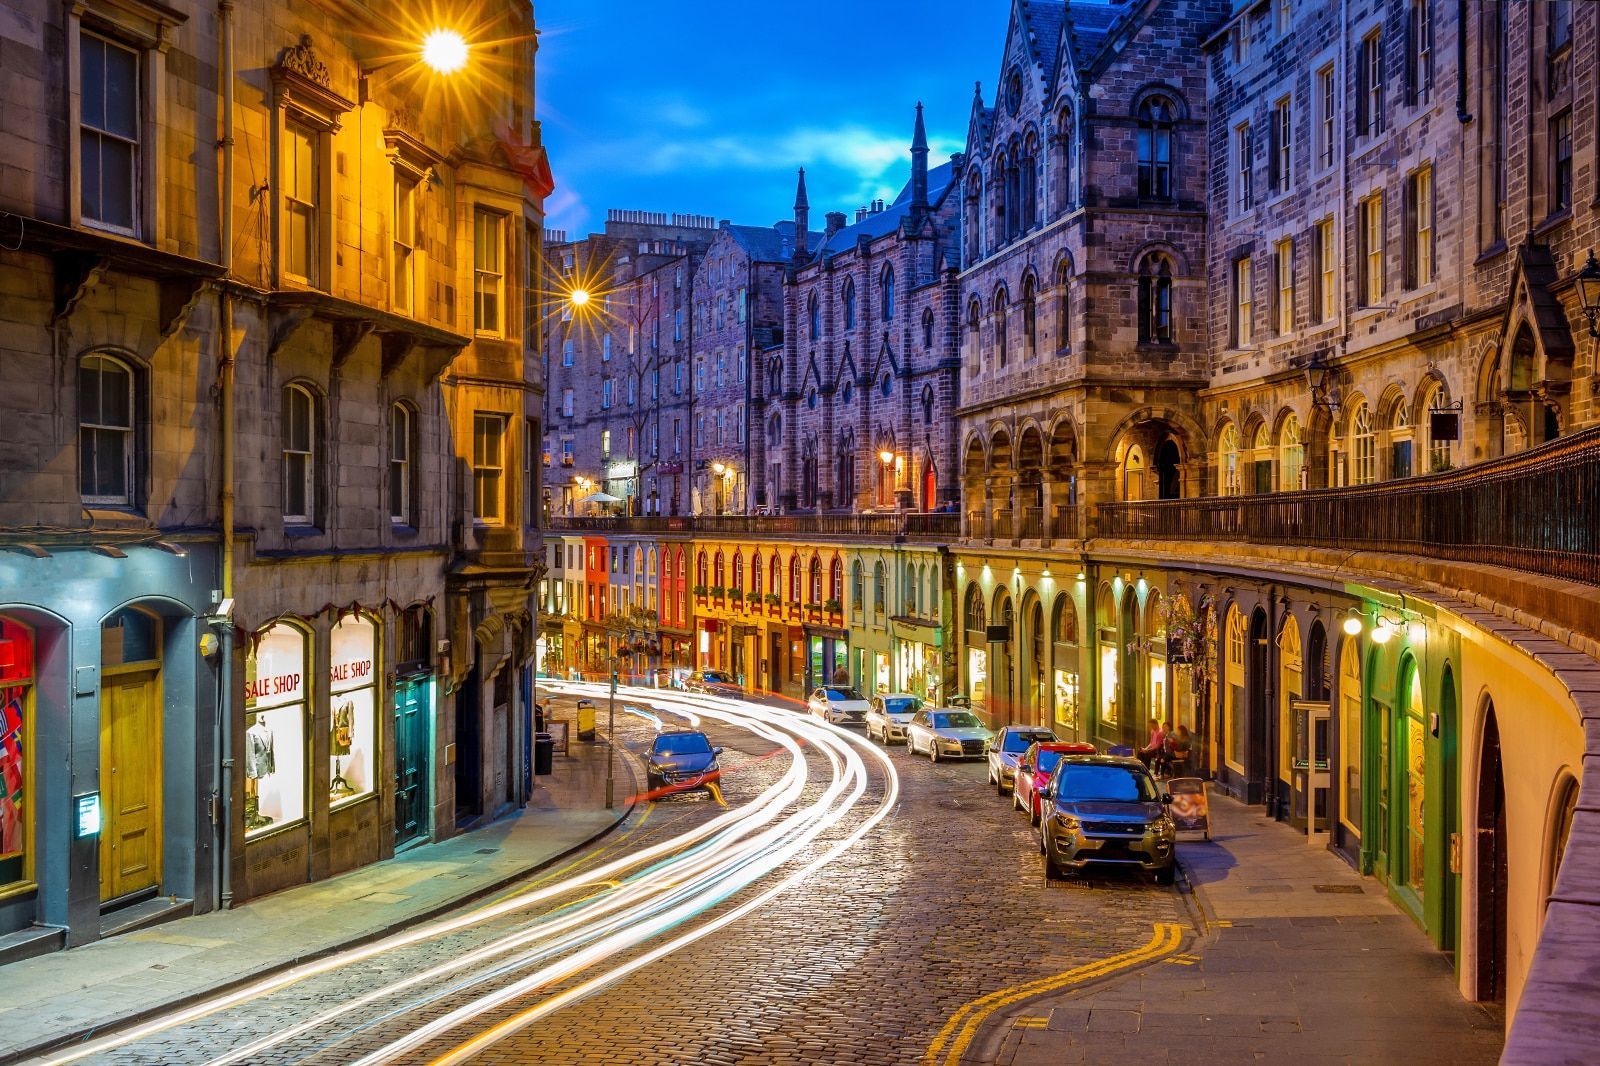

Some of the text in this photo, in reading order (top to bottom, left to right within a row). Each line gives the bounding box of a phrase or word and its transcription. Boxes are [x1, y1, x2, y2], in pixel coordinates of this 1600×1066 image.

[351, 660, 371, 678] SHOP
[245, 673, 300, 700] SALE SHOP
